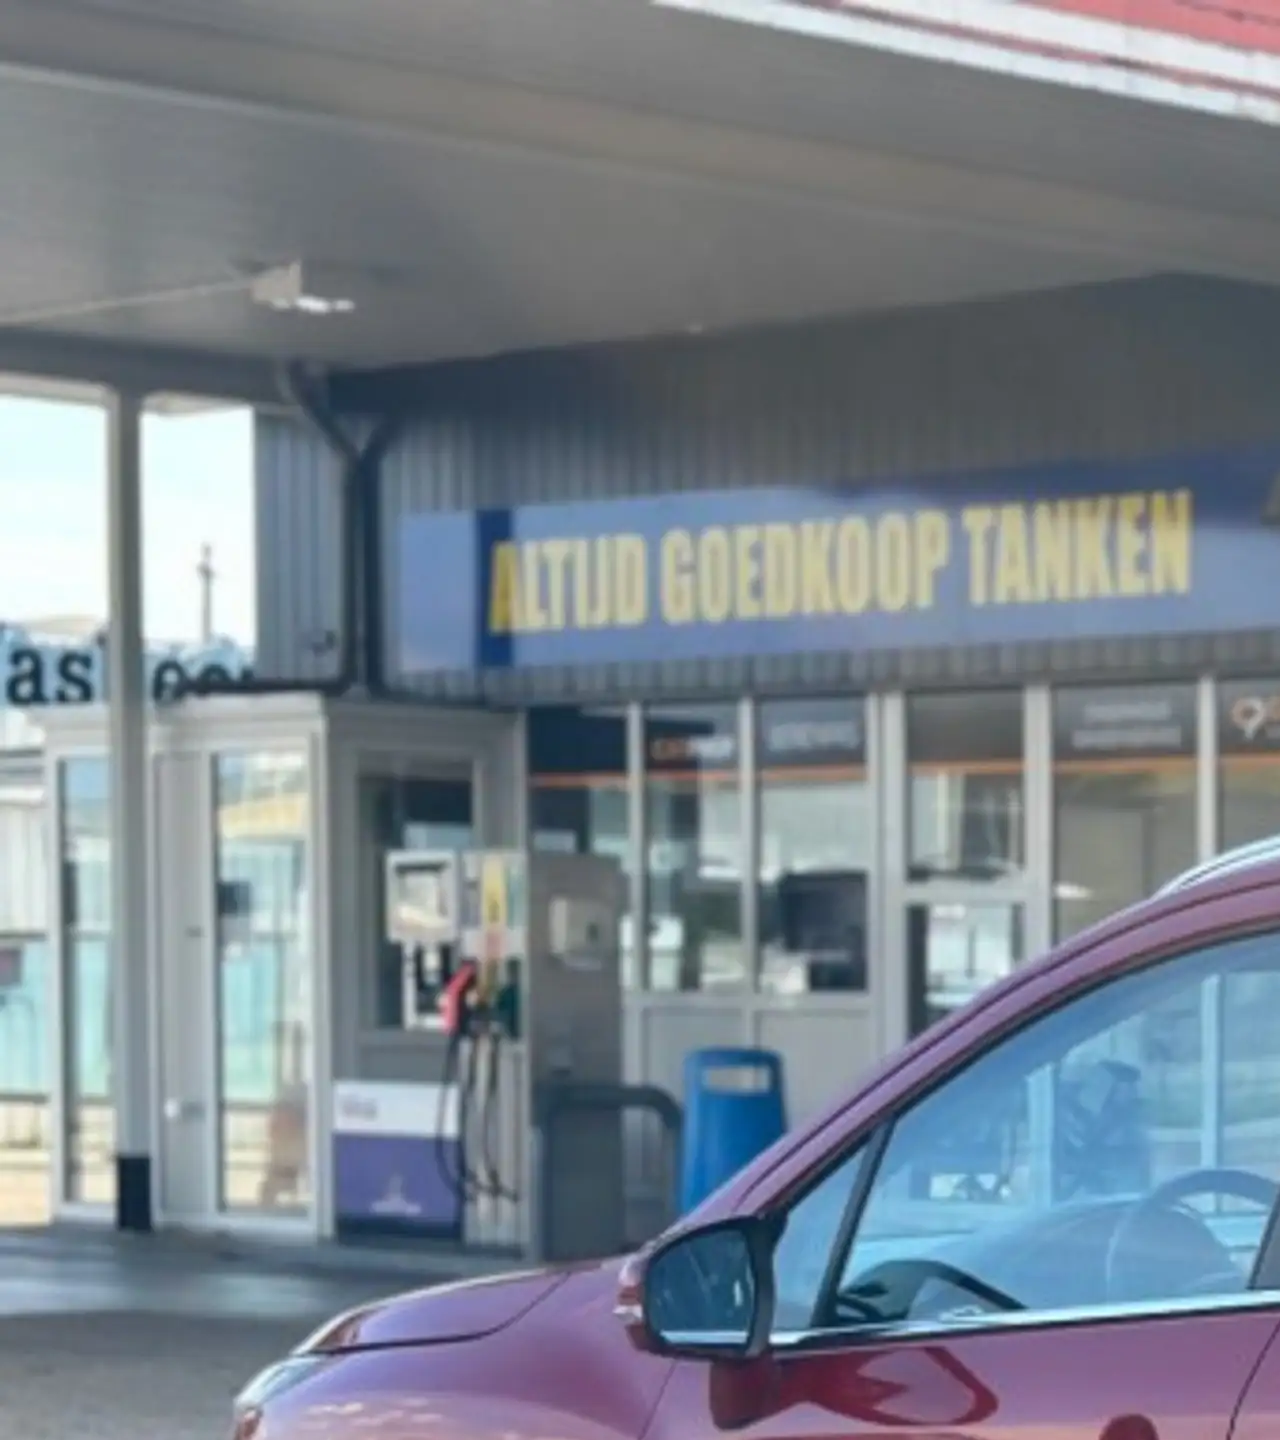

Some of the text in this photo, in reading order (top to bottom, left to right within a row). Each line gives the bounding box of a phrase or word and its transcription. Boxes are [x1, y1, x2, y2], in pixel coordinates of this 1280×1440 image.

[489, 490, 1194, 634] ALTIJD GOEDKOOP TANKEN
